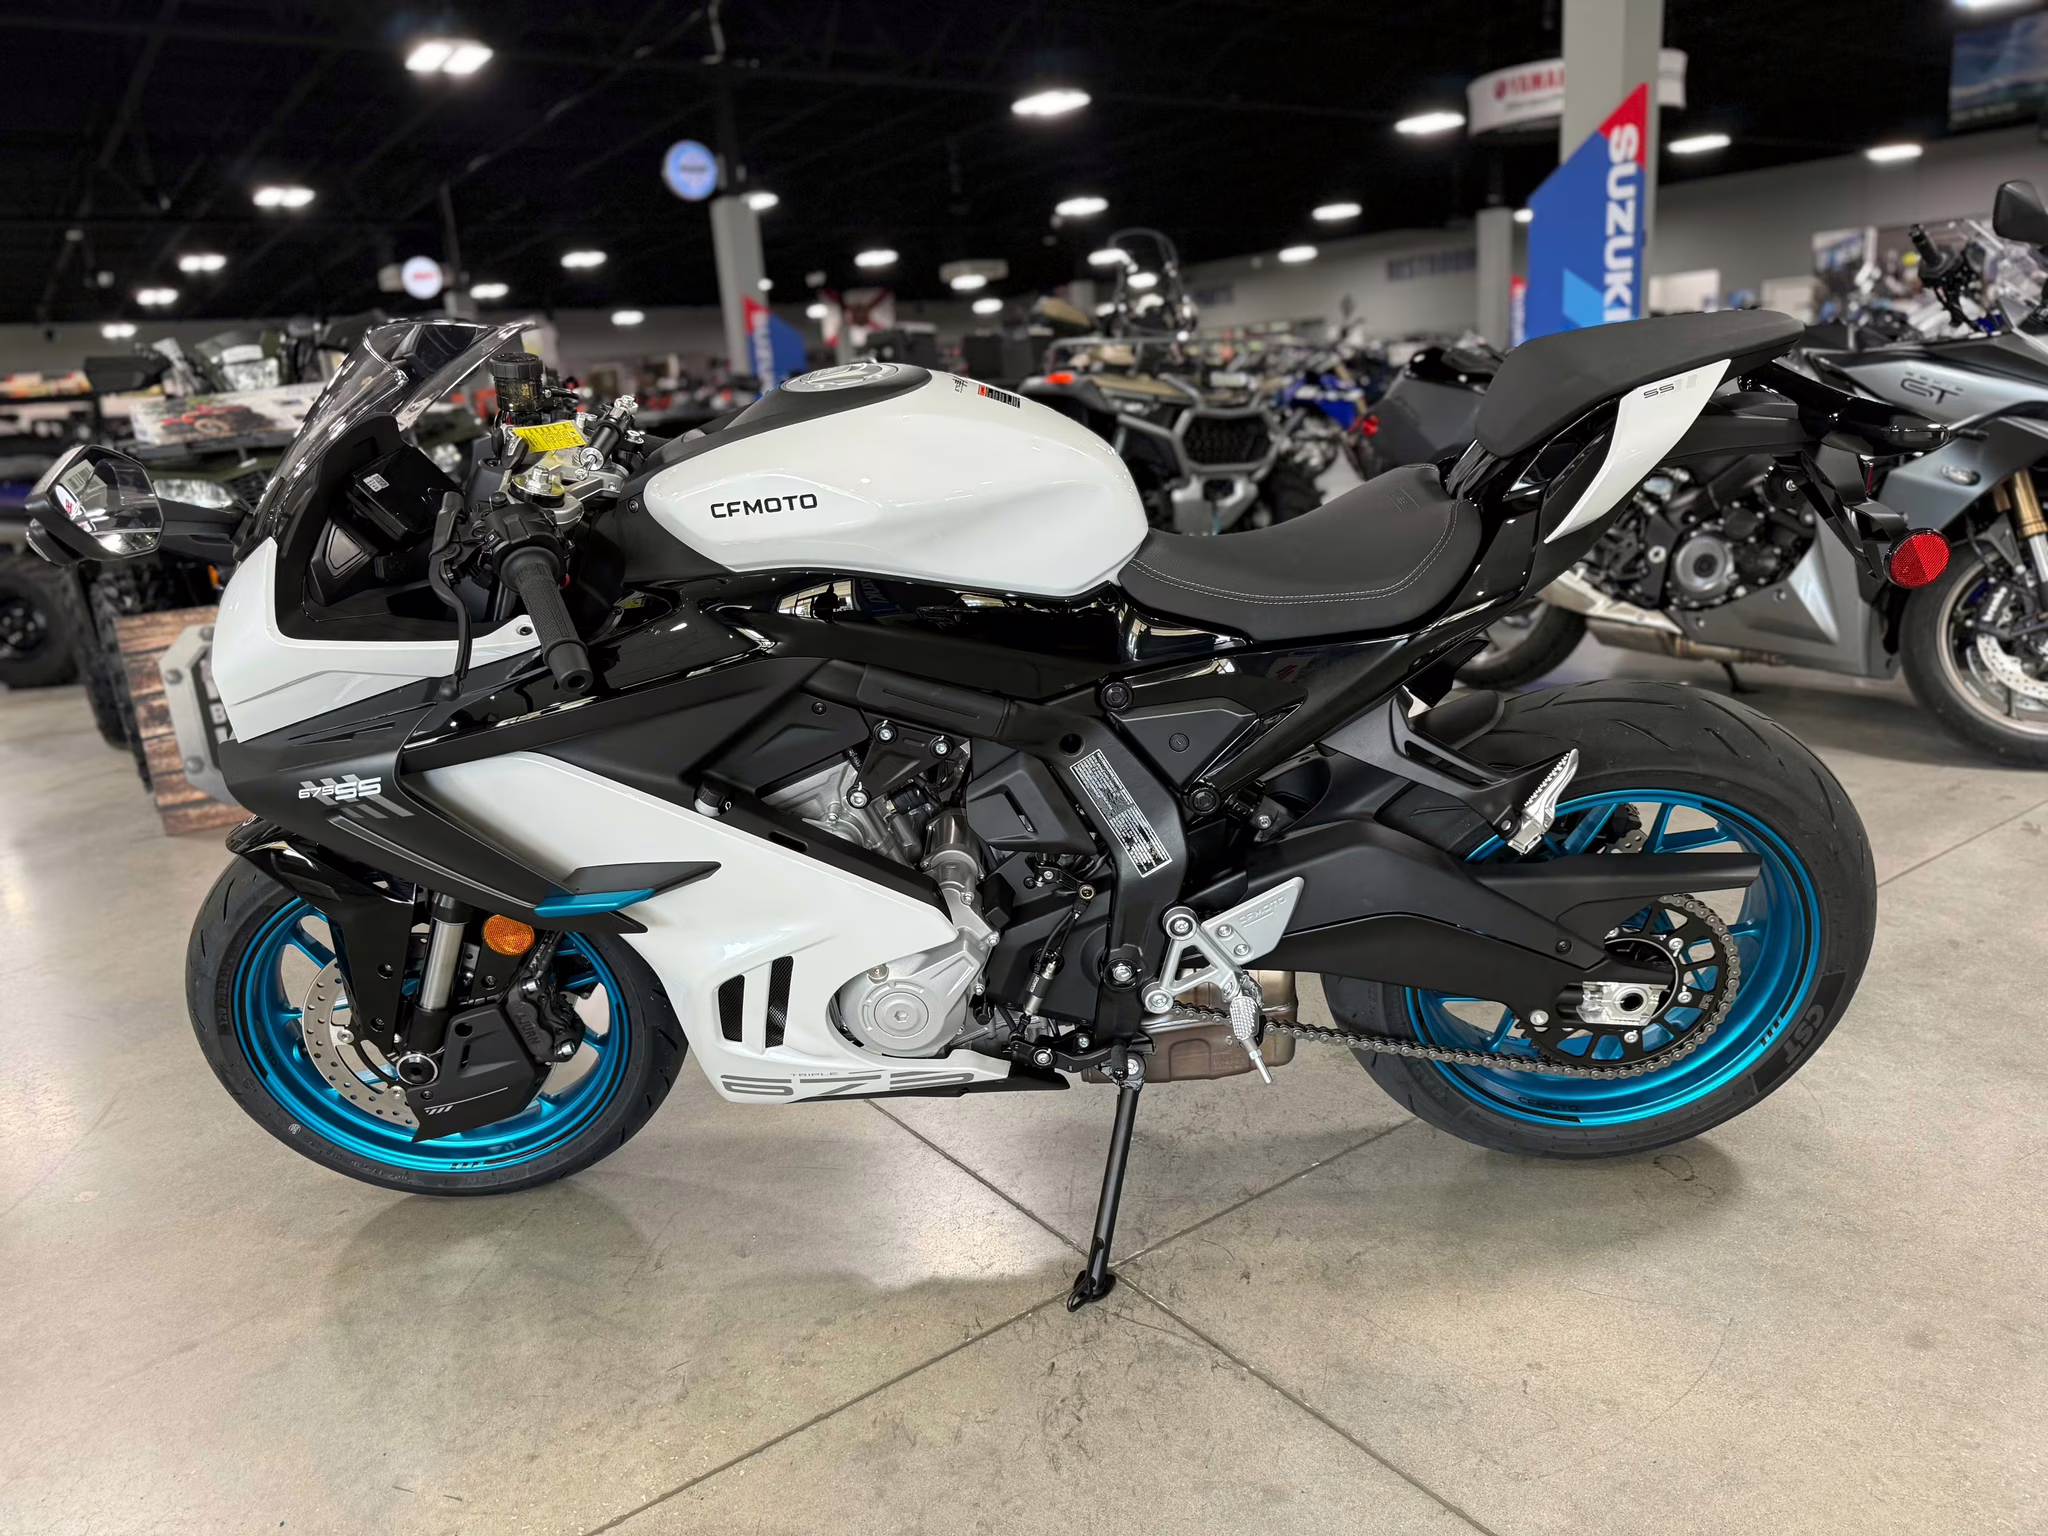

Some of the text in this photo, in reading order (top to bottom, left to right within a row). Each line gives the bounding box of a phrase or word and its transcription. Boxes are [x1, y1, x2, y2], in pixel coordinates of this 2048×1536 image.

[1510, 68, 1565, 95] YAMA
[1603, 122, 1640, 322] SUZUKI
[1643, 383, 1675, 399] SS
[710, 493, 818, 519] CFMOTO
[1238, 896, 1287, 924] CFMOTO
[1782, 1003, 1825, 1065] CST
